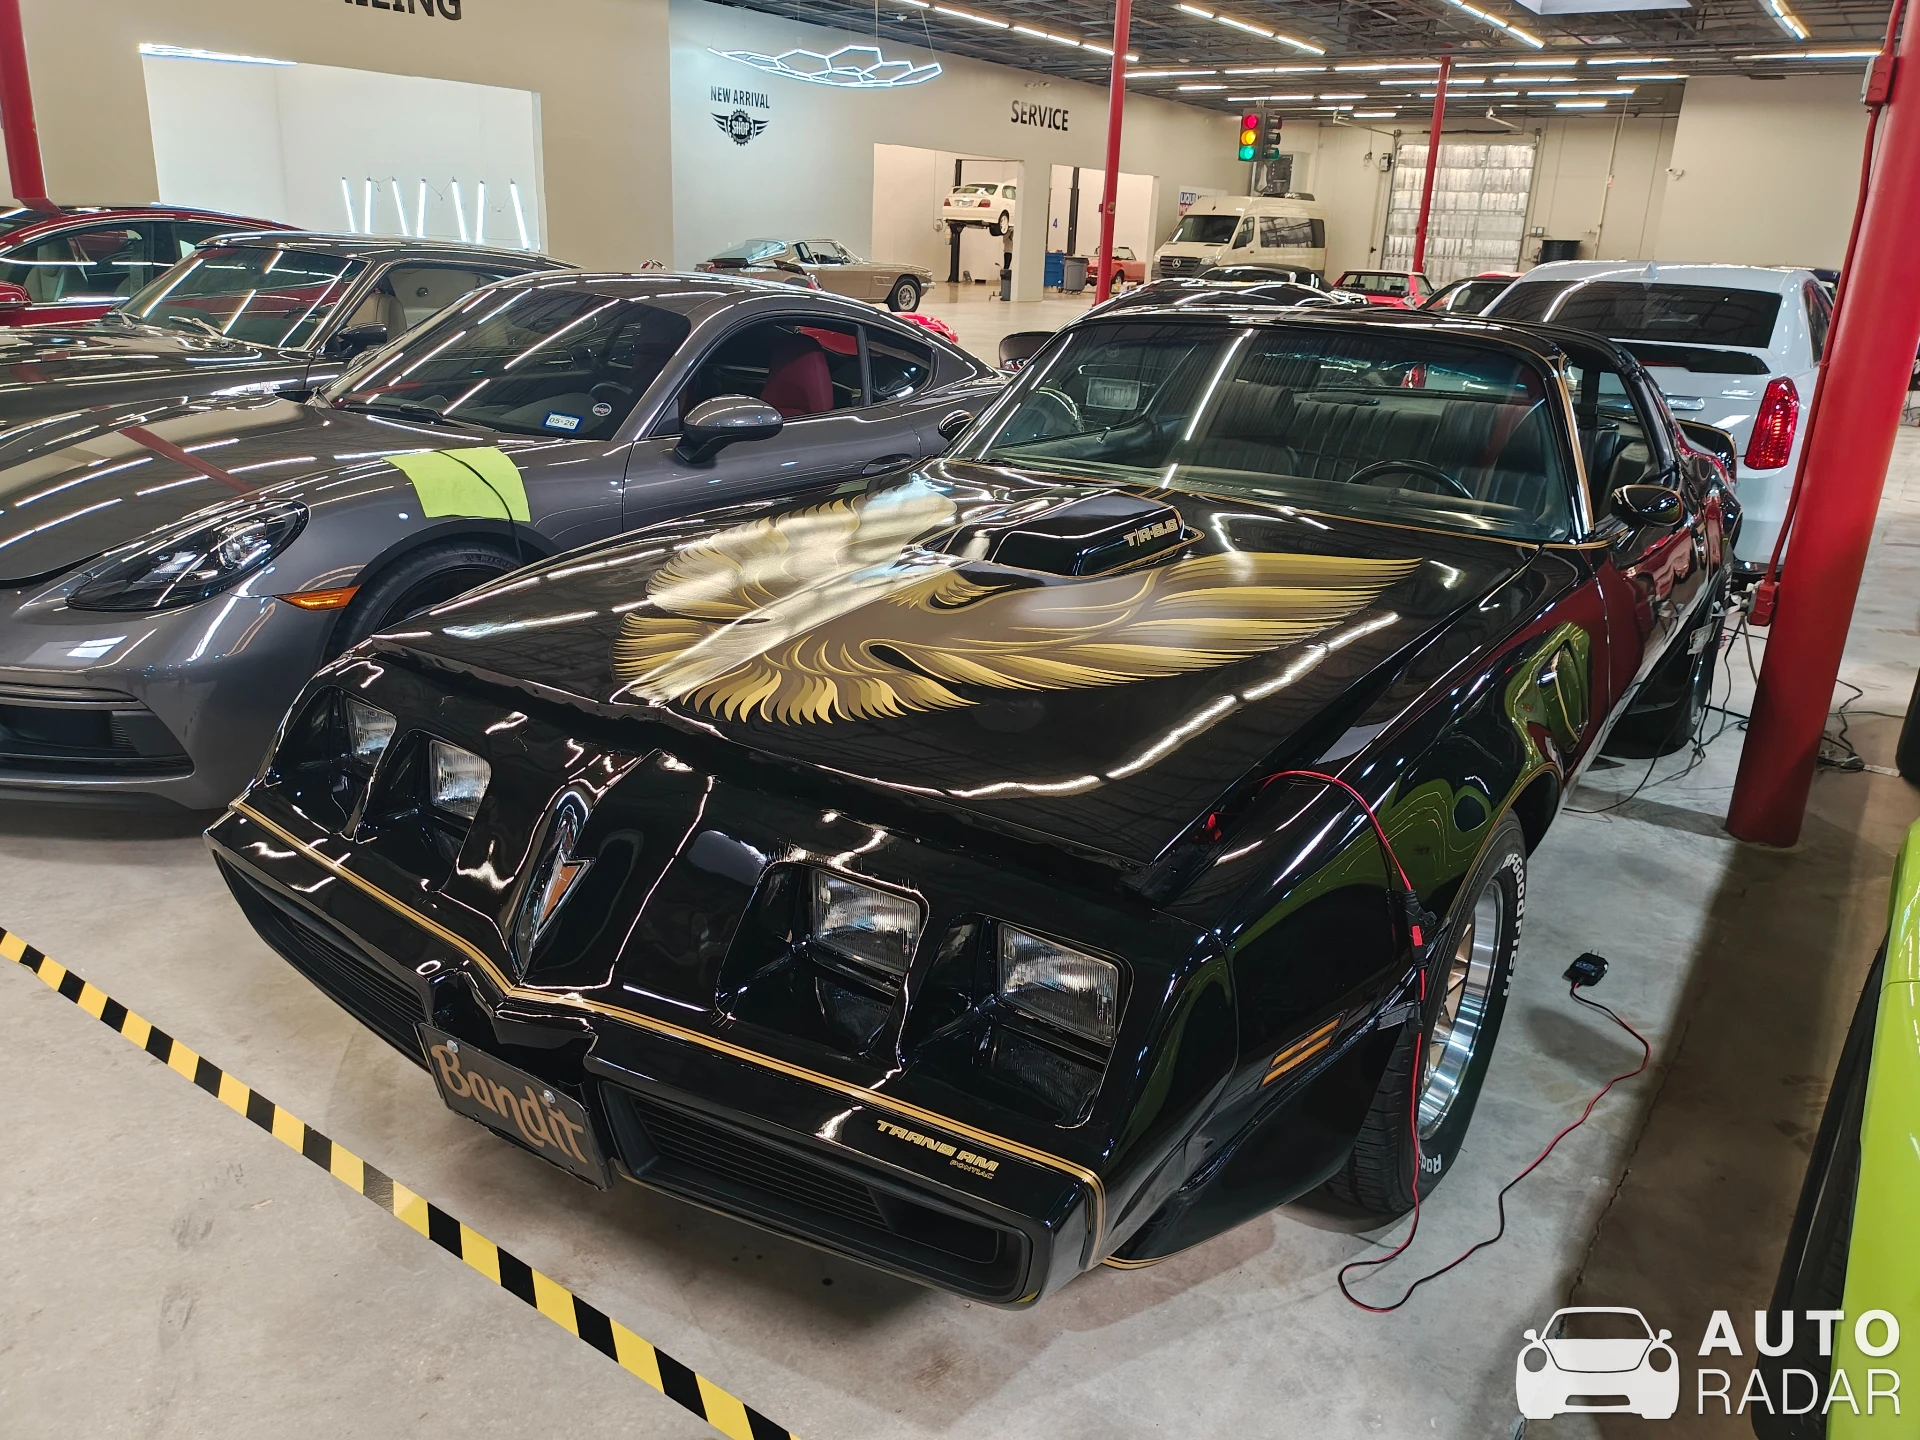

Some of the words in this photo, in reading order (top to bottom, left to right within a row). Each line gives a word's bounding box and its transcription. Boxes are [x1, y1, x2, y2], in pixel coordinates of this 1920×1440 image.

[710, 86, 731, 103] NEW
[733, 89, 770, 109] ARRIVAL
[1011, 100, 1069, 132] SERVICE
[731, 120, 750, 136] SHOP
[1052, 217, 1058, 229] 4
[430, 1044, 589, 1165] Bandit
[876, 1119, 957, 1157] TRANS
[956, 1150, 1000, 1172] AM
[949, 1159, 995, 1180] PONTIAC
